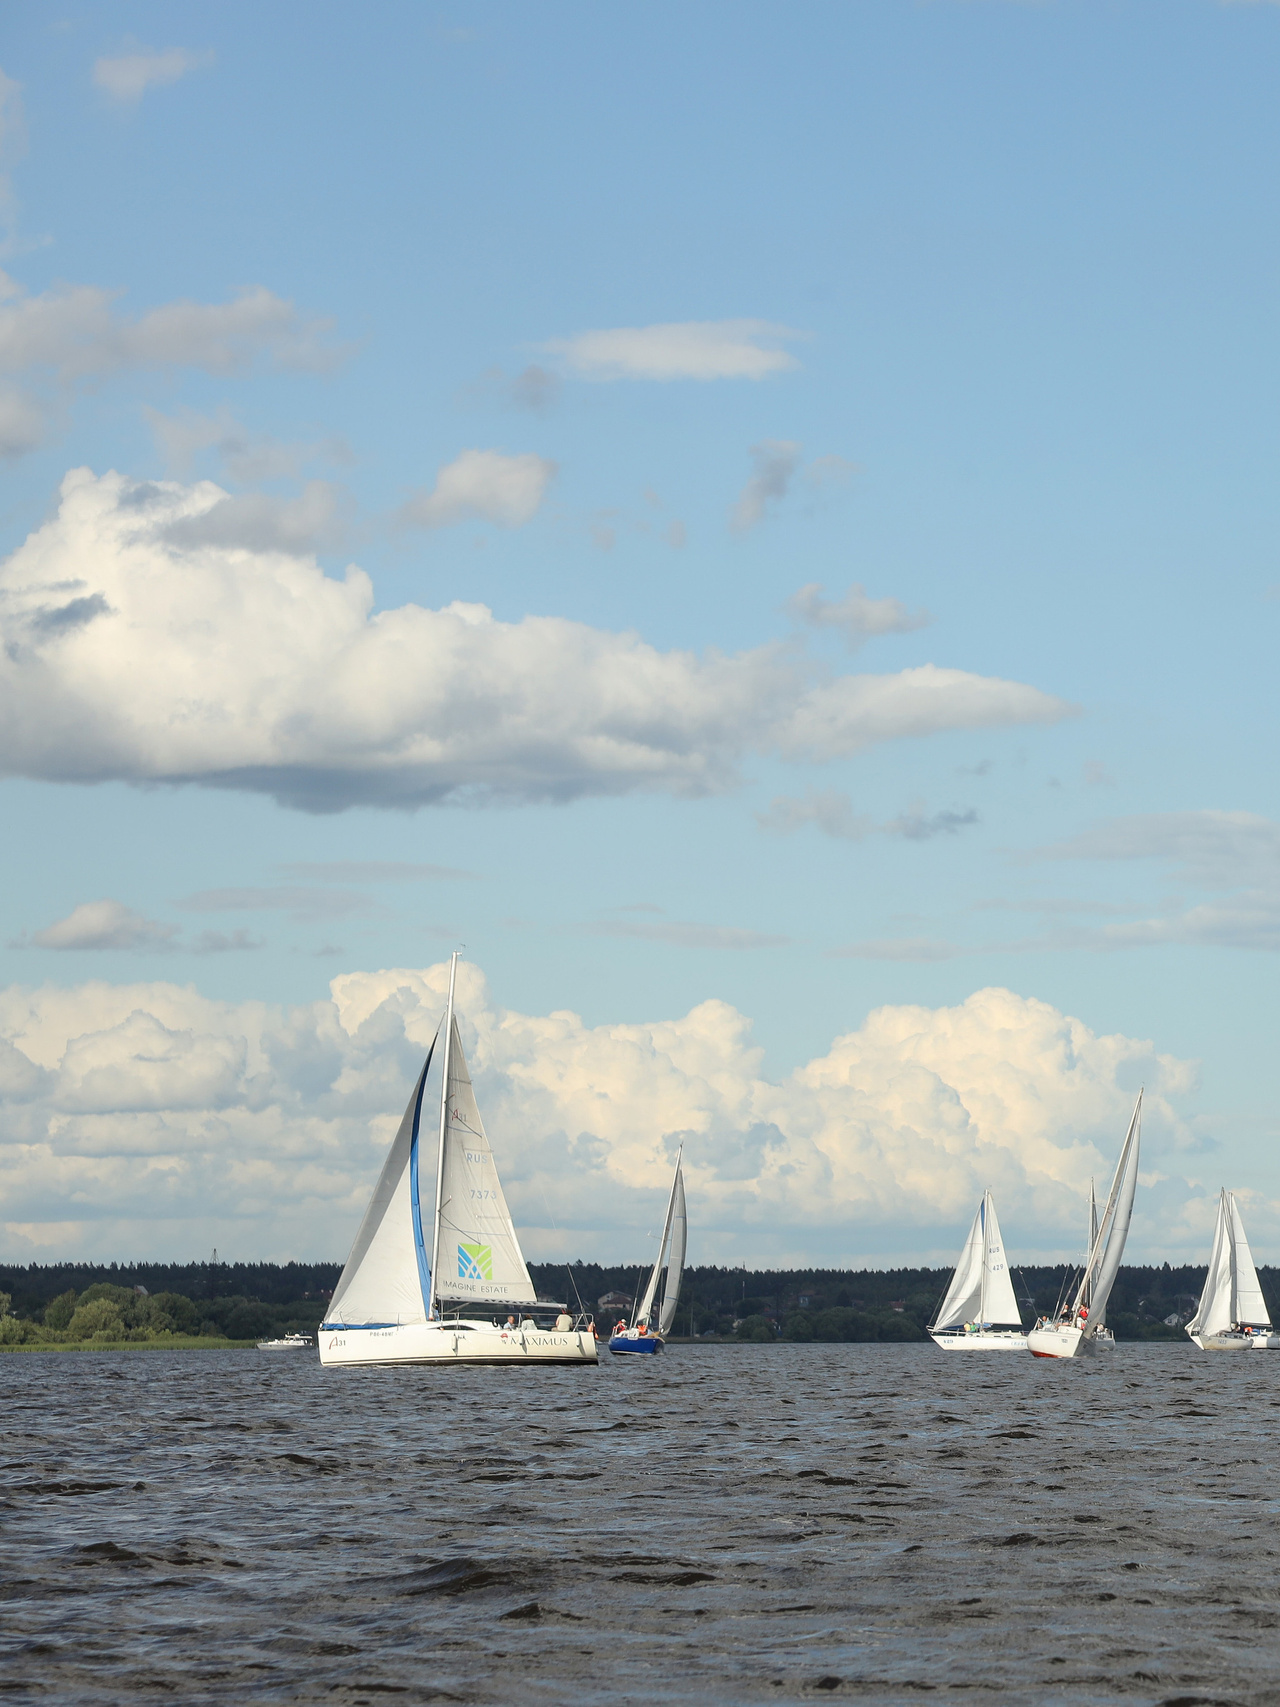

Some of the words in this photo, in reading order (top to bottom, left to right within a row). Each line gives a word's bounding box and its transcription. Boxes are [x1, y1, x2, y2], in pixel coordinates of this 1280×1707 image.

[466, 1153, 488, 1163] RUS
[470, 1189, 497, 1199] 7373
[443, 1281, 476, 1292] IMAGINE
[480, 1285, 508, 1293] ESTATE
